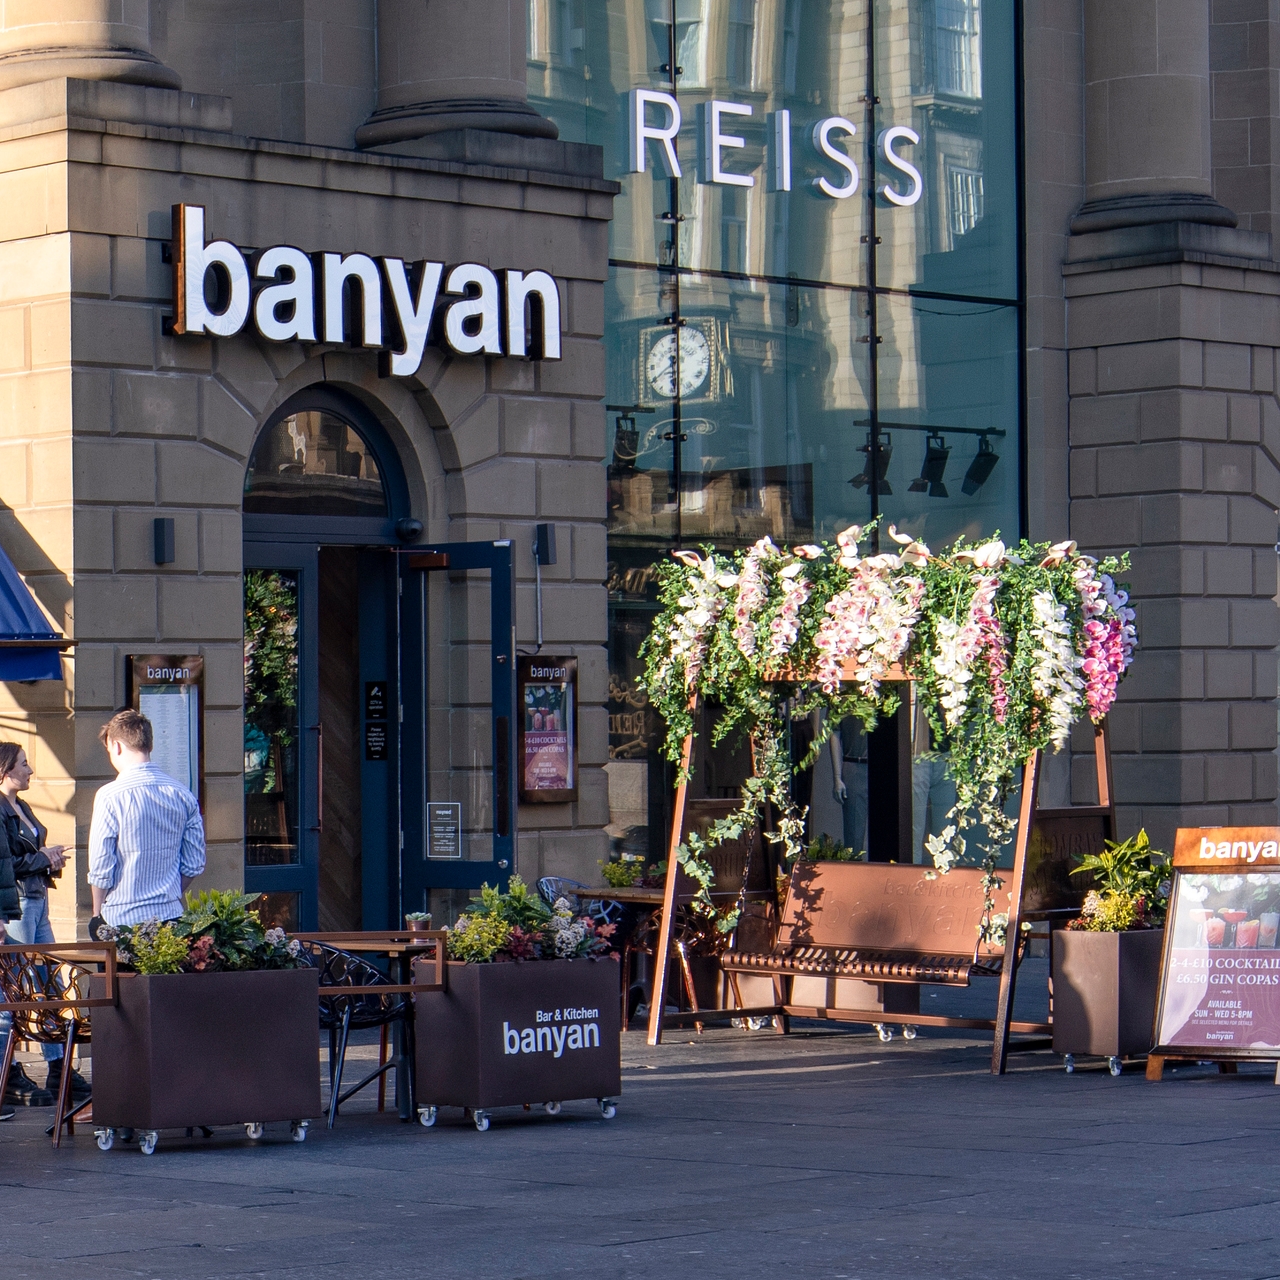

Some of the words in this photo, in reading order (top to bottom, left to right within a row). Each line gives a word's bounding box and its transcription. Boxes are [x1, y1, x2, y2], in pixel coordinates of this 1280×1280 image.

[629, 88, 923, 207] REISS
[172, 203, 562, 378] banyan
[147, 666, 190, 681] banyan
[530, 664, 566, 680] banyan
[1199, 837, 1280, 863] banya
[883, 878, 985, 900] bar&kitche
[1176, 974, 1207, 984] £6.50
[1210, 974, 1234, 984] GIN
[1237, 974, 1279, 985] COPAS
[1208, 1000, 1242, 1009] AVAILABLE
[536, 1010, 553, 1023] Bar
[554, 1009, 561, 1021] &
[564, 1007, 599, 1020] Kitchen
[1215, 1010, 1230, 1018] WED
[503, 1021, 600, 1058] banyan
[1206, 1033, 1234, 1041] banyan
